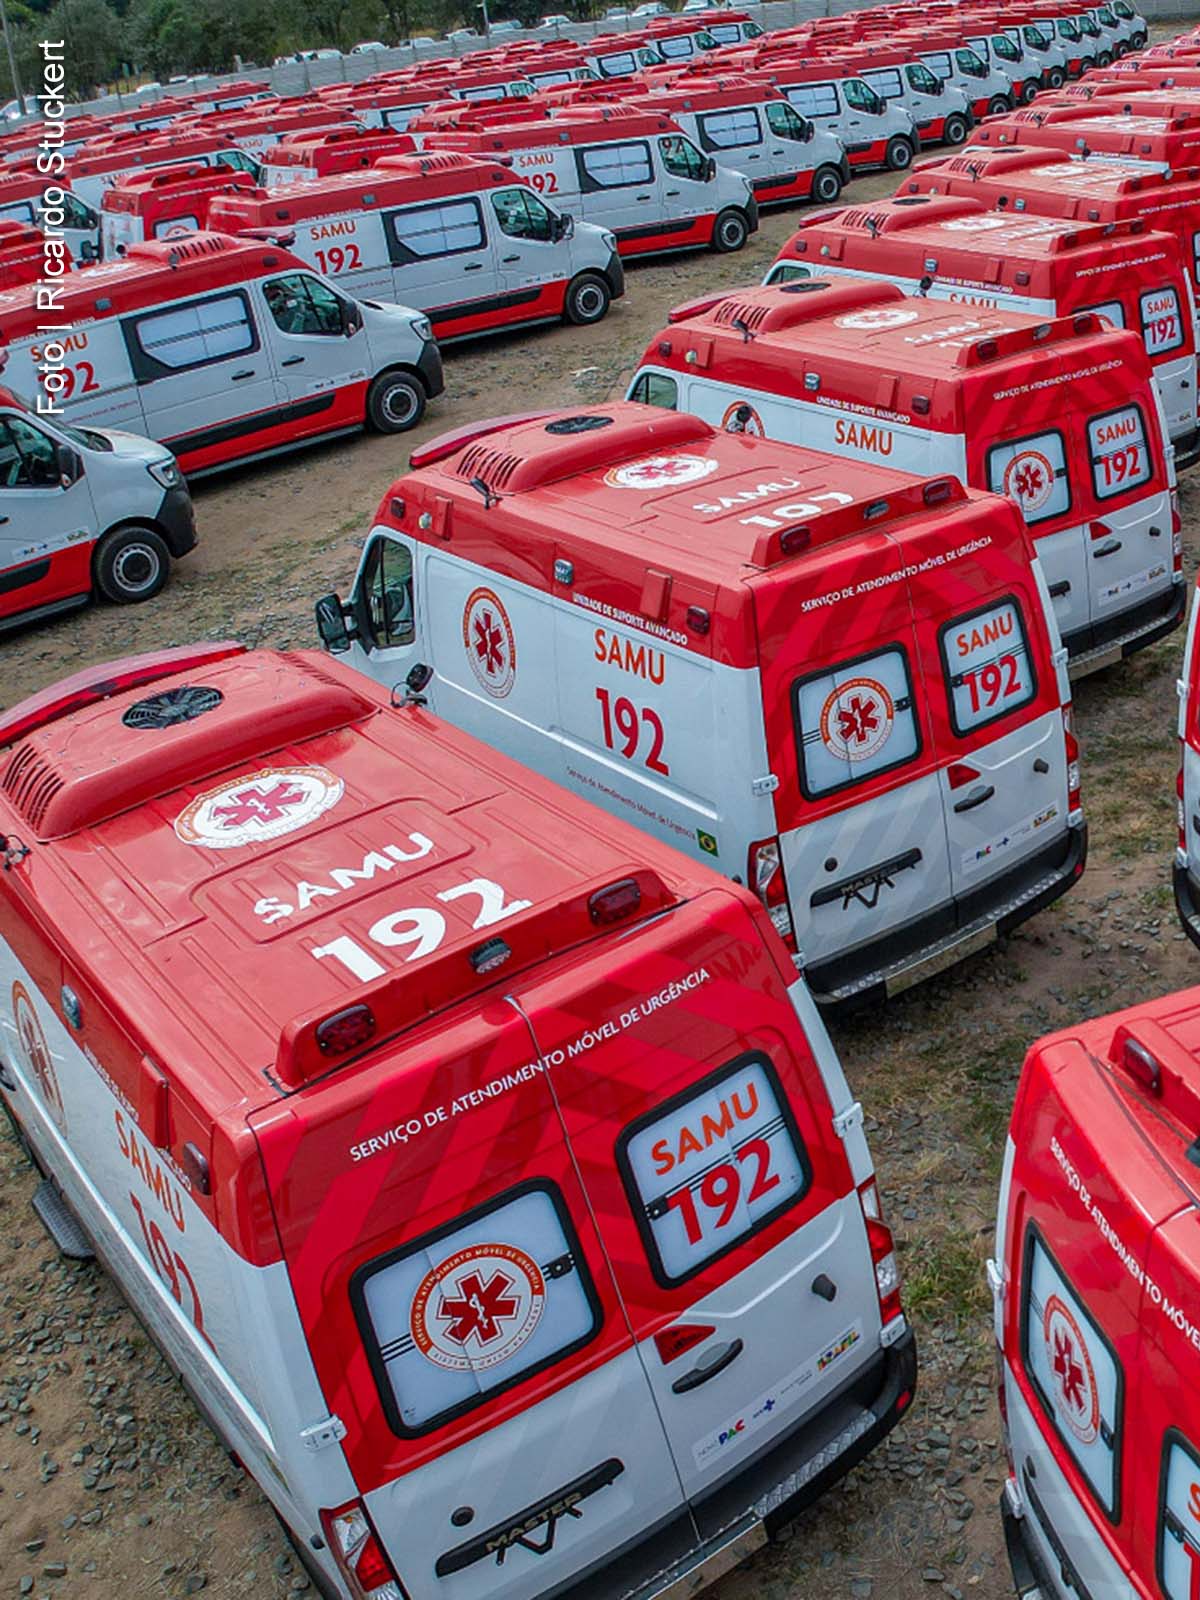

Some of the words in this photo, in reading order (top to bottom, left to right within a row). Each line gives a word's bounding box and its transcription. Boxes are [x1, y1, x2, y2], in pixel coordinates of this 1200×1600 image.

[519, 153, 554, 168] SAMU
[310, 220, 356, 241] SAMU
[314, 243, 363, 275] 192
[1147, 297, 1175, 315] SAMU
[1150, 315, 1176, 345] 192
[835, 419, 893, 456] SAMU
[1096, 416, 1137, 446] SAMU
[1100, 445, 1141, 487] 192
[841, 586, 855, 600] DE
[594, 628, 665, 686] SAMU
[956, 612, 1014, 657] SAMU
[962, 654, 1022, 714] 192
[594, 687, 670, 777] 192
[253, 831, 435, 925] SAMU
[310, 877, 535, 983] 192
[350, 1119, 422, 1163] SERVIÇO
[424, 1106, 449, 1127] DE
[450, 1049, 565, 1116] ATENDIMENTO
[567, 1021, 620, 1058] MÓVEL
[620, 1008, 641, 1030] DE
[641, 967, 711, 1017] URGÊNCIA
[651, 1082, 760, 1176] SAMU
[114, 1108, 185, 1233] SAMU
[665, 1137, 781, 1246] 192
[718, 1419, 746, 1445] PAC
[485, 1491, 582, 1552] MASTER
